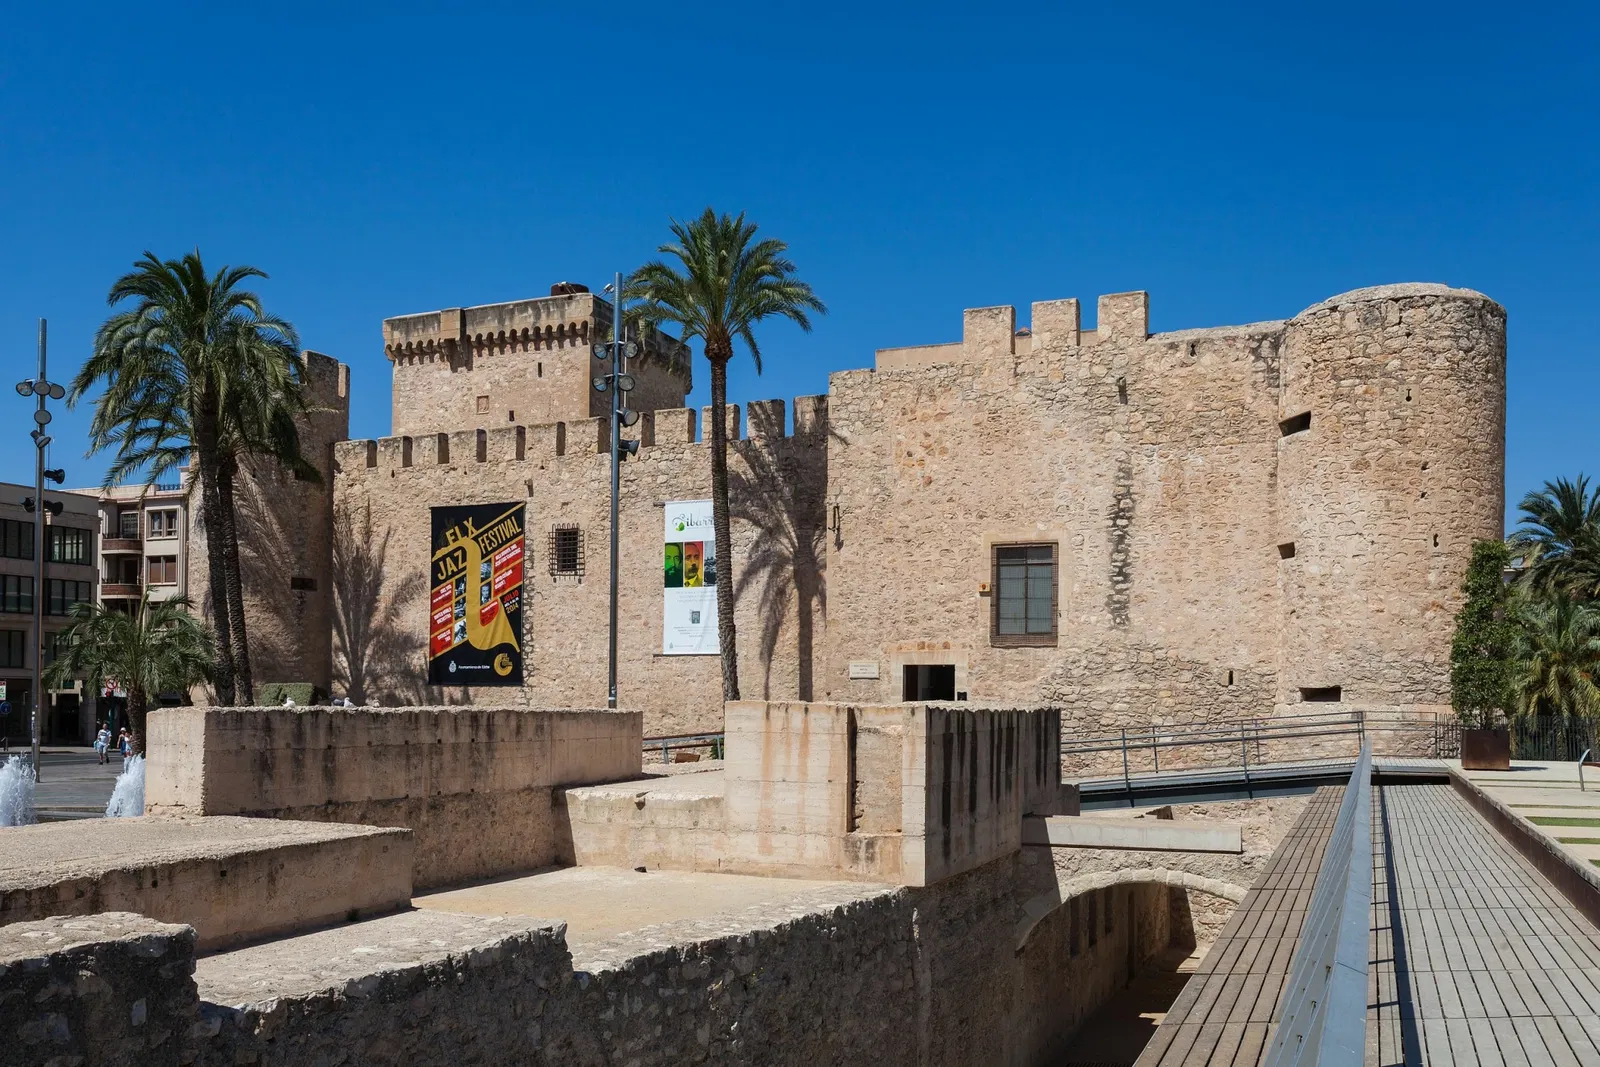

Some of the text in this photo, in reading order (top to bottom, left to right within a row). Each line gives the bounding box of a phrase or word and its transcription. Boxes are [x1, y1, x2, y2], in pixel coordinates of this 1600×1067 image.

[446, 516, 477, 545] ELX
[478, 516, 522, 554] FESTIVAL
[503, 589, 519, 603] JULIO
[506, 602, 519, 614] 2014
